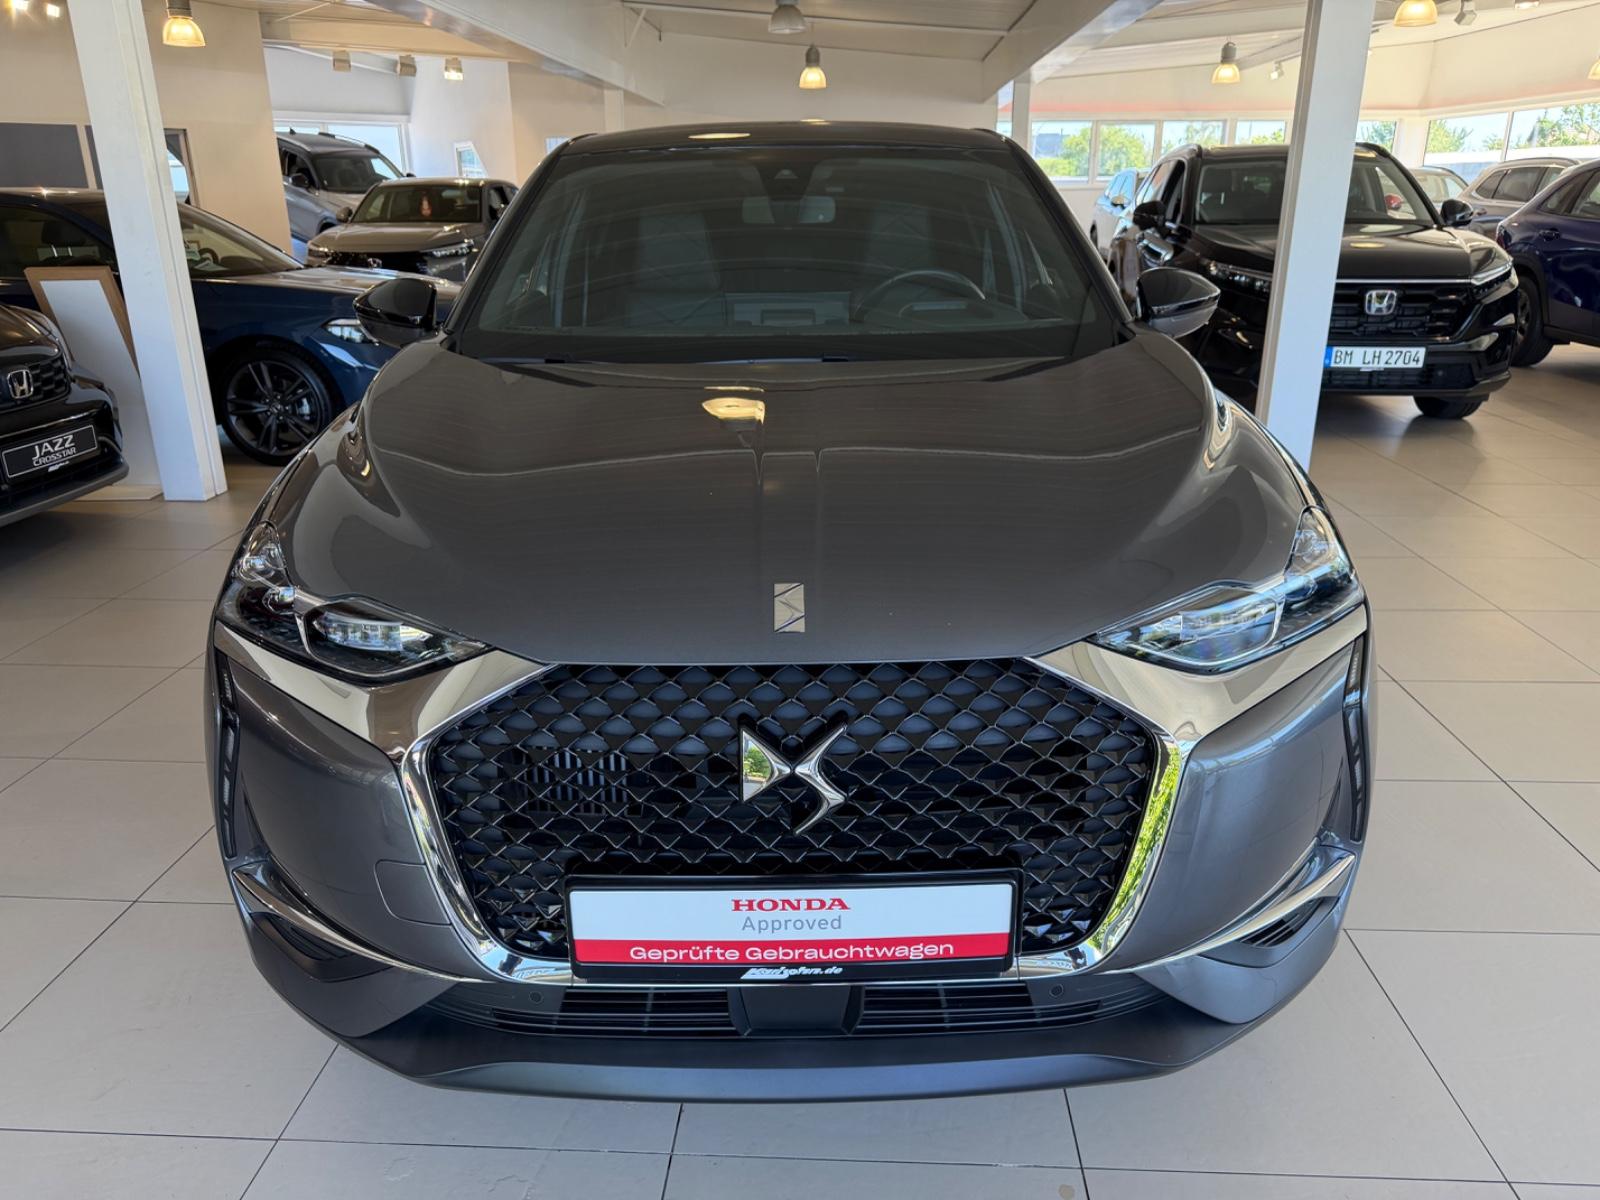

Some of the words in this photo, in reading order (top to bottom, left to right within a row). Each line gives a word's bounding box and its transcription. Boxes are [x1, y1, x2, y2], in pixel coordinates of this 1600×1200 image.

[1334, 350, 1353, 365] BM
[32, 434, 75, 460] JAZZ
[32, 447, 77, 466] CROSSTAR
[731, 898, 851, 912] HONDA
[742, 915, 842, 933] Approved
[629, 945, 740, 964] Geprüfte
[745, 941, 955, 962] Gebrauchtwagen
